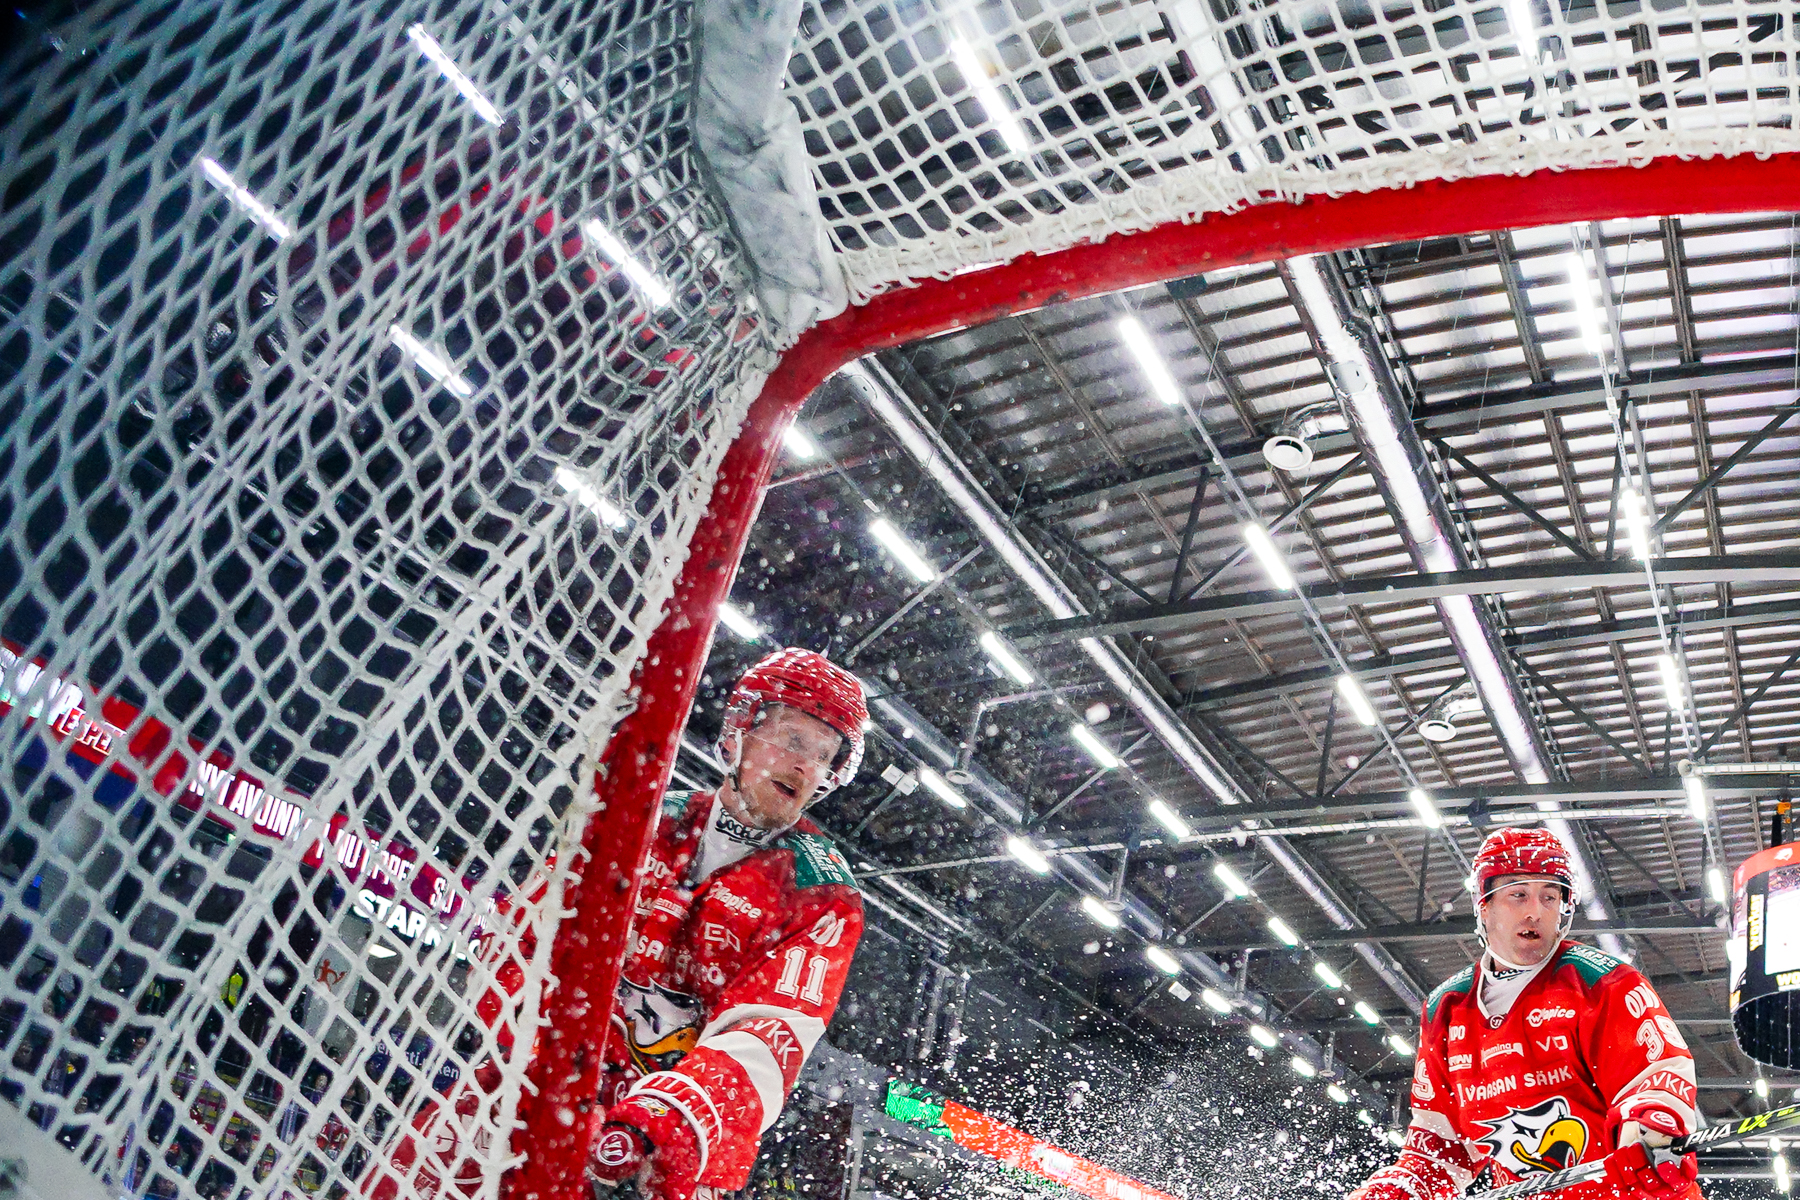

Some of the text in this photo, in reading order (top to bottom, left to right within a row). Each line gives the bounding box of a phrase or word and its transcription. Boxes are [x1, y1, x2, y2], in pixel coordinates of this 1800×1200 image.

[1749, 893, 1762, 951] worker
[775, 945, 831, 1006] 11
[1636, 1014, 1689, 1063] 39
[1524, 1066, 1573, 1087] SÄHK
[1685, 1123, 1732, 1148] PHA
